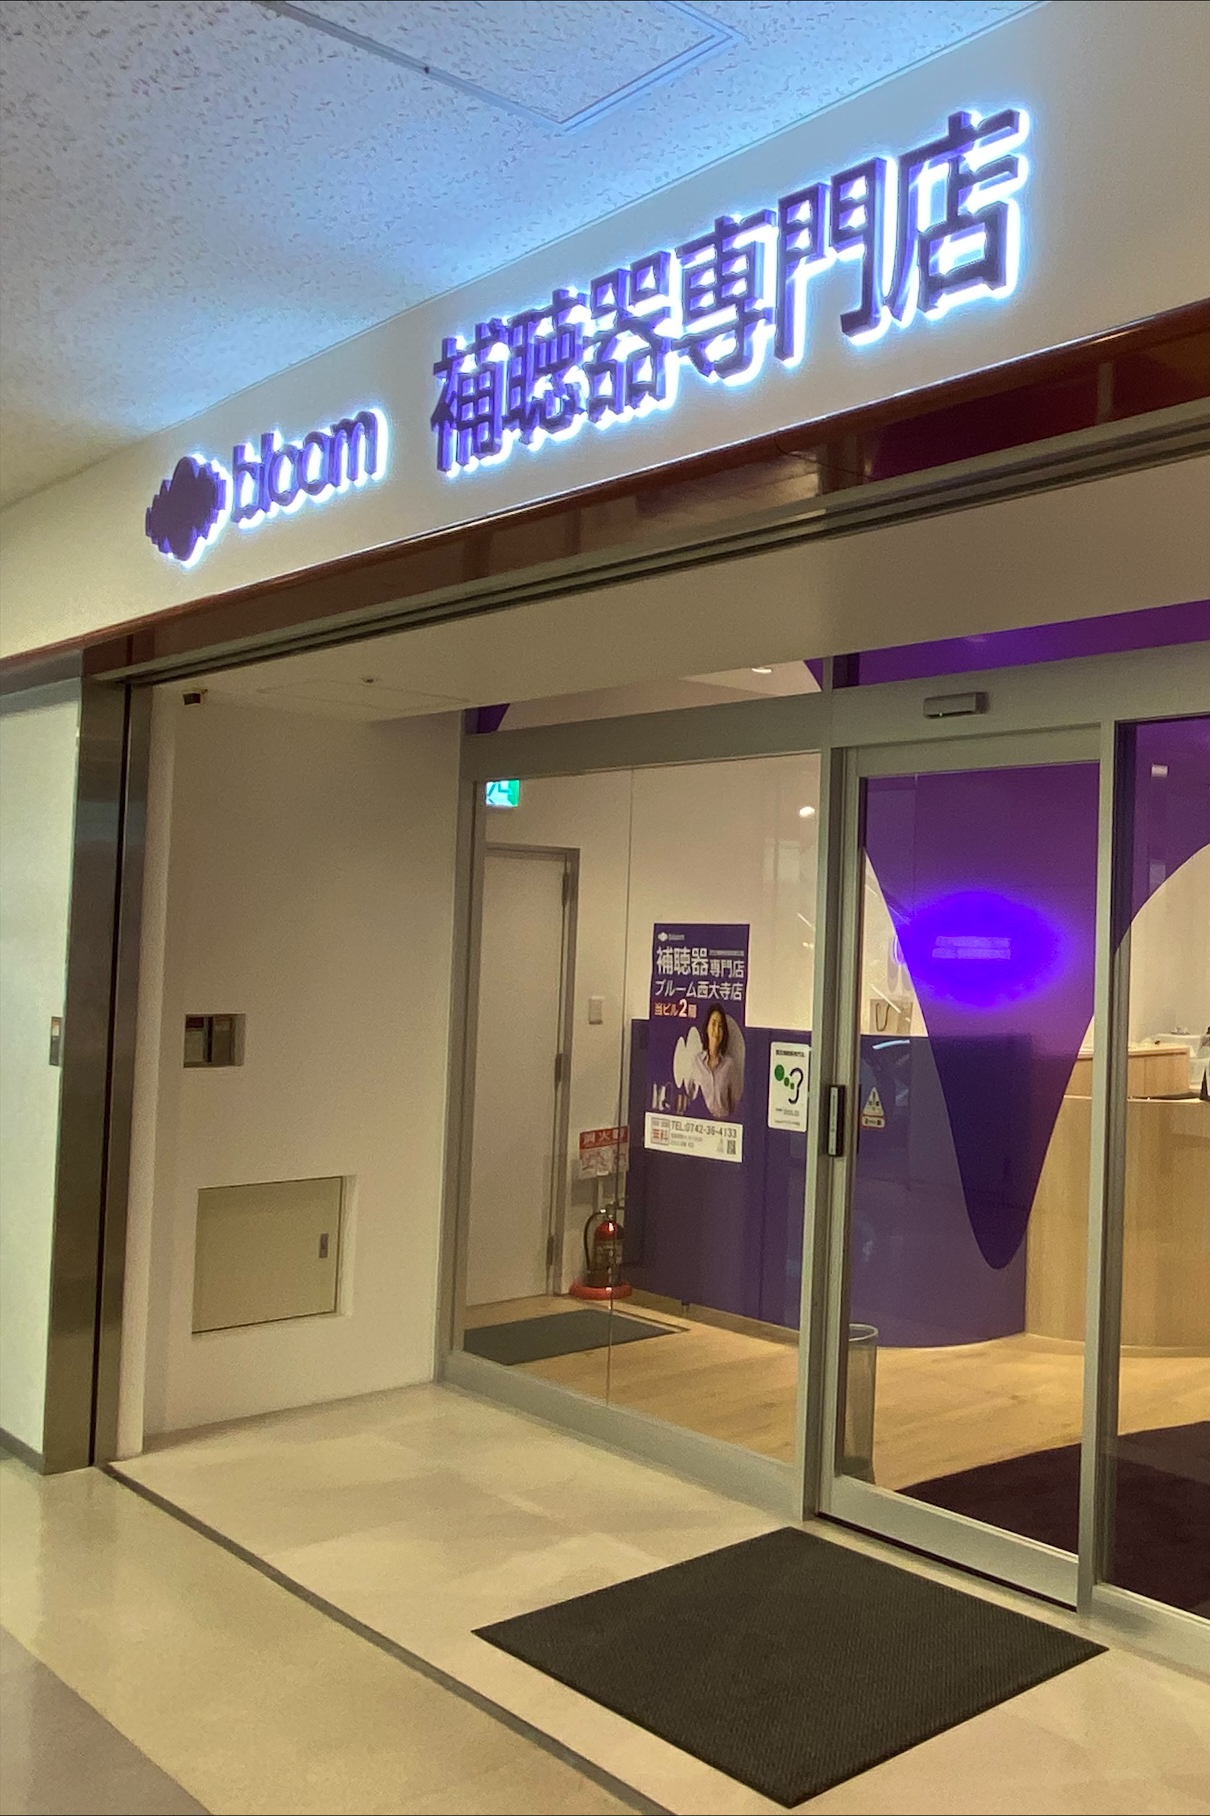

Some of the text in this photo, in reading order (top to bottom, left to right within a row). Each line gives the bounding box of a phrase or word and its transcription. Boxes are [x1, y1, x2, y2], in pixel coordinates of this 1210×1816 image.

[430, 109, 1022, 474] 補聴器専門店
[231, 410, 380, 524] bloom
[655, 979, 744, 1001] ブルーム西大寺店
[656, 946, 745, 978] 補聴器 専門店
